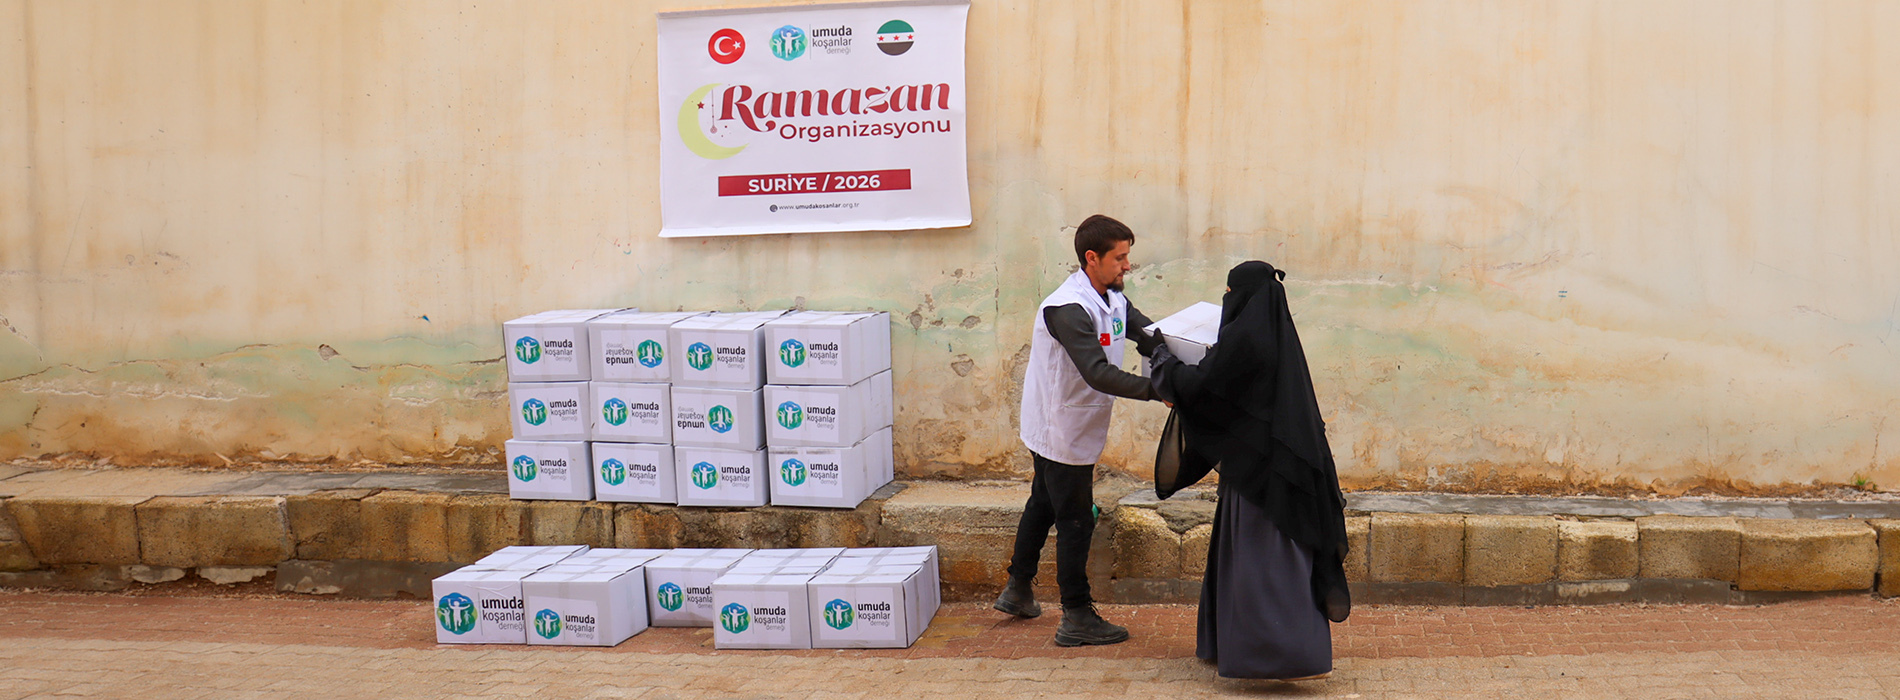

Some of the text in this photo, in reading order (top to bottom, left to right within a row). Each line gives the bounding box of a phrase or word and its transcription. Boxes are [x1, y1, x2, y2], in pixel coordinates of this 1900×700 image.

[812, 25, 852, 38] umuda
[812, 37, 852, 49] koşanlar
[826, 46, 851, 55] derneği
[717, 82, 950, 132] Ramazan
[779, 119, 951, 142] Organizasyonu
[748, 174, 881, 193] SURİYE / 2026
[779, 202, 859, 210] www.umudakosanlar.org.tr
[544, 339, 573, 348] umuda
[809, 342, 838, 351] umuda
[545, 349, 573, 357] koşanlar
[606, 348, 633, 357] koşanlar
[717, 346, 746, 355] umuda
[717, 355, 746, 364] koşanlar
[809, 351, 838, 360] koşanlar
[606, 356, 634, 365] umuda
[549, 399, 577, 408] umuda
[631, 401, 659, 411] umuda
[550, 408, 578, 416] koşanlar
[631, 410, 659, 420] koşanlar
[807, 406, 836, 415] umuda
[677, 411, 704, 421] koşanlar
[807, 414, 835, 424] koşanlar
[677, 420, 705, 430] umuda
[540, 458, 567, 467] umuda
[810, 462, 838, 471] umuda
[540, 467, 567, 476] koşanlar
[629, 463, 657, 472] umuda
[721, 465, 750, 474] umuda
[629, 472, 657, 481] koşanlar
[721, 474, 750, 484] koşanlar
[810, 470, 838, 480] koşanlar
[686, 585, 712, 594] umud
[481, 596, 524, 609] umuda
[687, 594, 713, 604] koşanla
[753, 605, 786, 616] umuda
[857, 601, 891, 611] umuda
[482, 609, 524, 623] koşanlar
[565, 614, 595, 624] umuda
[754, 615, 786, 625] koşanlar
[858, 611, 891, 620] koşanlar
[498, 621, 525, 632] derneğ
[565, 623, 595, 633] koşanlar
